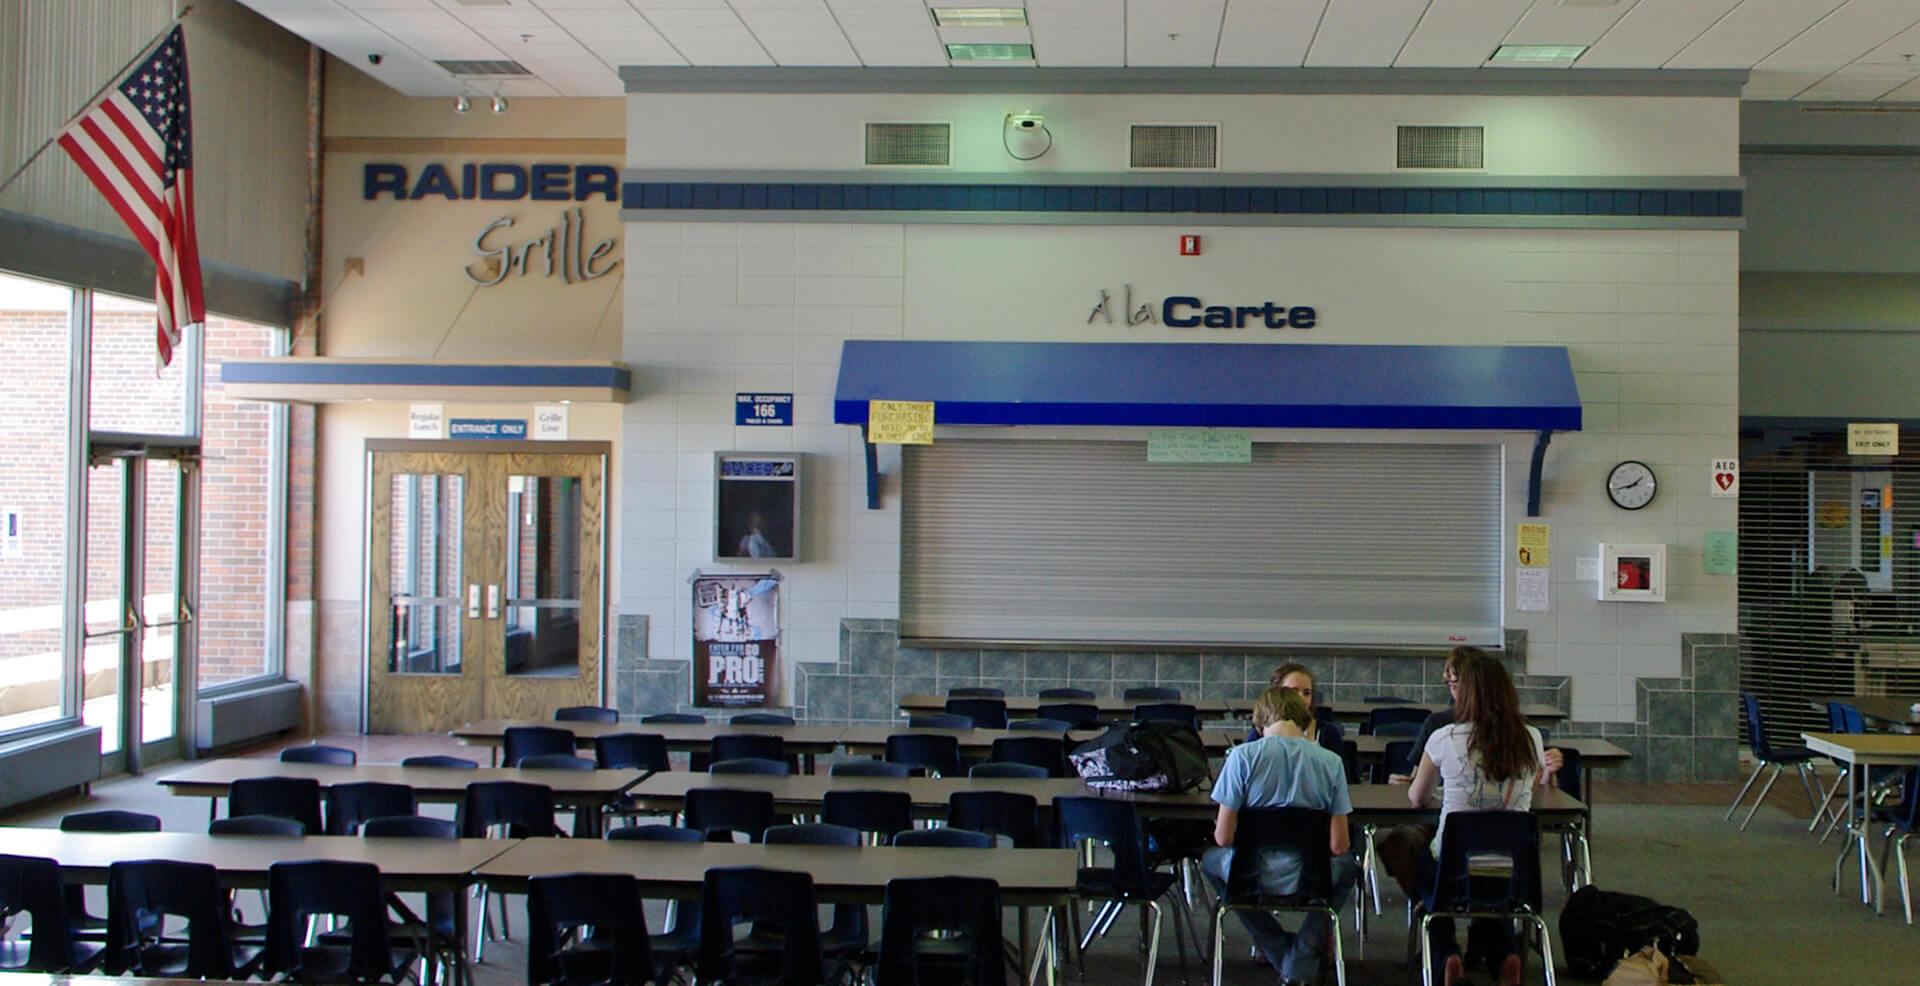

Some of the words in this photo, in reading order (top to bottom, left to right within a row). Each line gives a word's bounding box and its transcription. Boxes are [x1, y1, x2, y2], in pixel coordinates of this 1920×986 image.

[363, 163, 619, 202] RAIDER
[464, 207, 623, 286] Grille
[1087, 288, 1113, 325] A
[1162, 295, 1316, 329] Carte
[754, 395, 791, 403] OCCUPANCY
[753, 404, 776, 417] 166
[411, 412, 441, 422] Regular
[451, 424, 498, 434] ENTRANCE
[501, 424, 524, 434] ONLY
[541, 424, 560, 432] Line
[1715, 461, 1735, 470] AED
[708, 656, 759, 684] PRO
